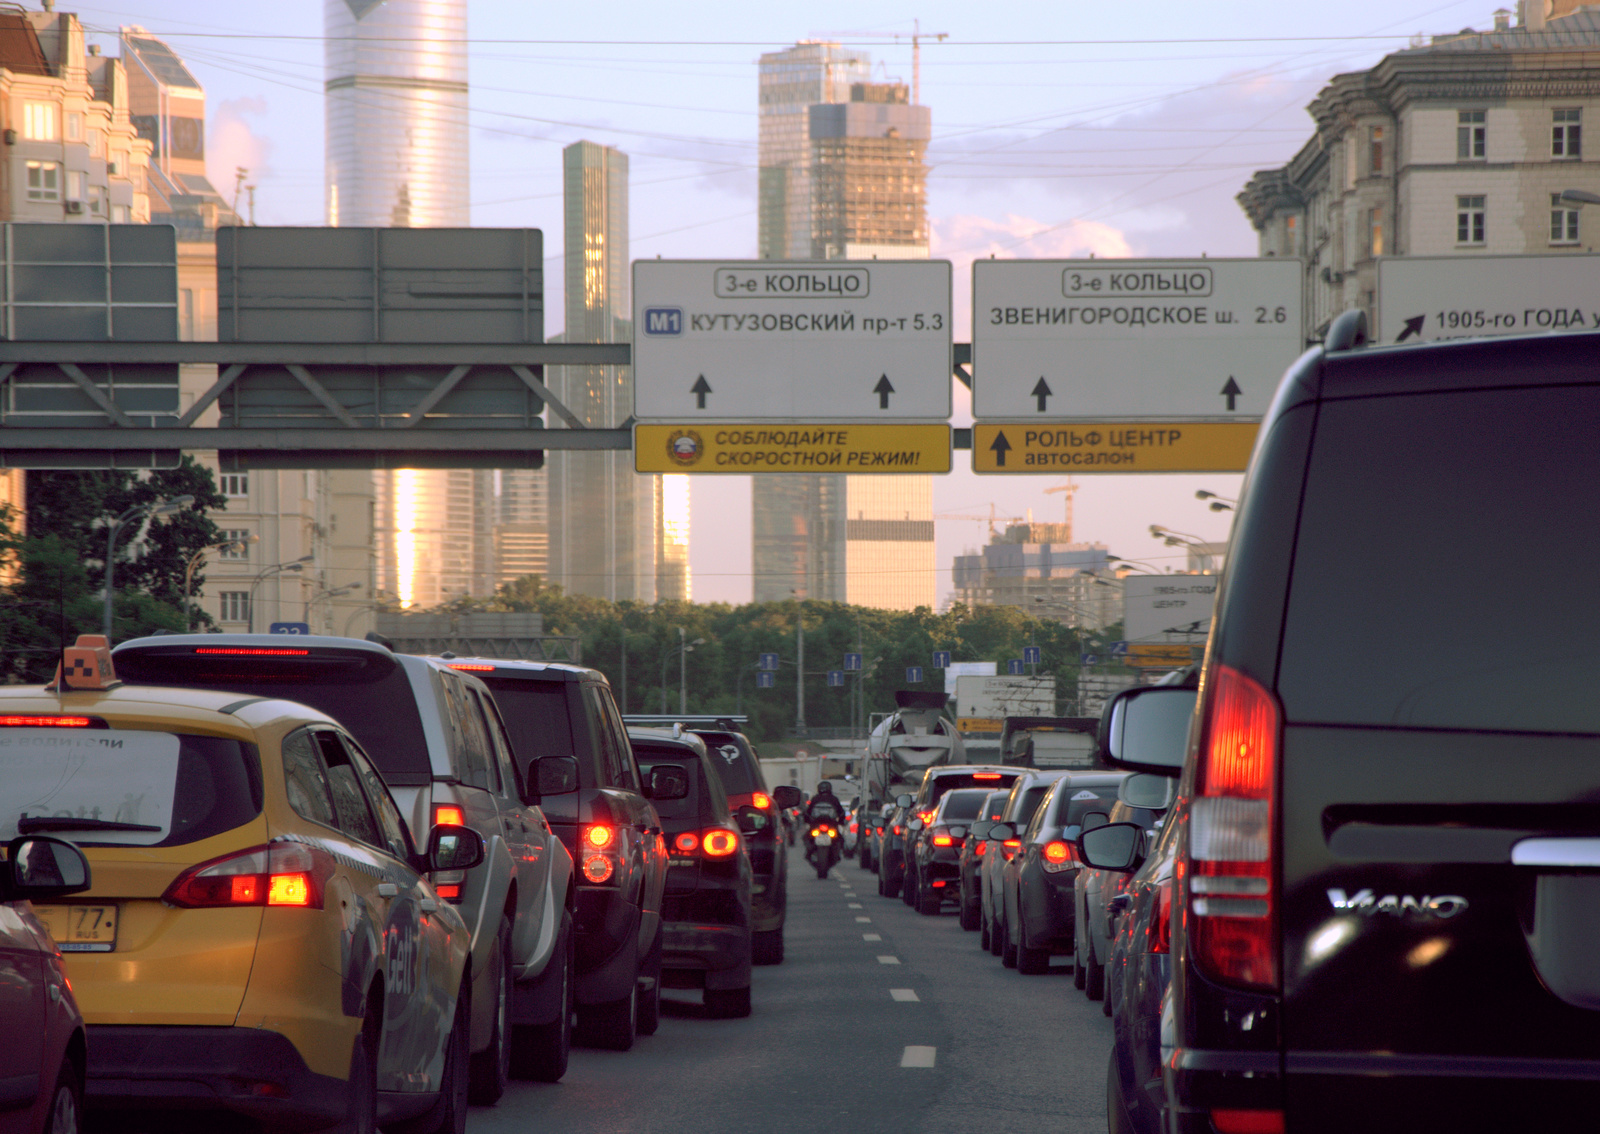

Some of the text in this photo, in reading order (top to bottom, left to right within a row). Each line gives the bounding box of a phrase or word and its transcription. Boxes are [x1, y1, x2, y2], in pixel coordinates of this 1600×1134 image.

[725, 274, 860, 295] 3-е КОЛЬЦО
[1070, 272, 1205, 294] 3-е КОЛЬЦО
[650, 312, 680, 332] M1
[691, 310, 943, 335] КУТУЗОВСКИЙ пр-т 5.3
[990, 306, 1287, 327] ЗВЕНИГОРОДСКОЕ ш. 2.6
[1436, 309, 1516, 329] 1905-го
[1523, 308, 1585, 329] ГОДА
[715, 429, 848, 447] СОБЛЮДАЙТЕ
[1025, 429, 1182, 449] РОЛЬФ ЦЕНТР
[715, 449, 920, 466] СКОРОСТНОЙ РЕЖИМ!
[1025, 452, 1135, 466] автосалон
[74, 907, 105, 931] 77
